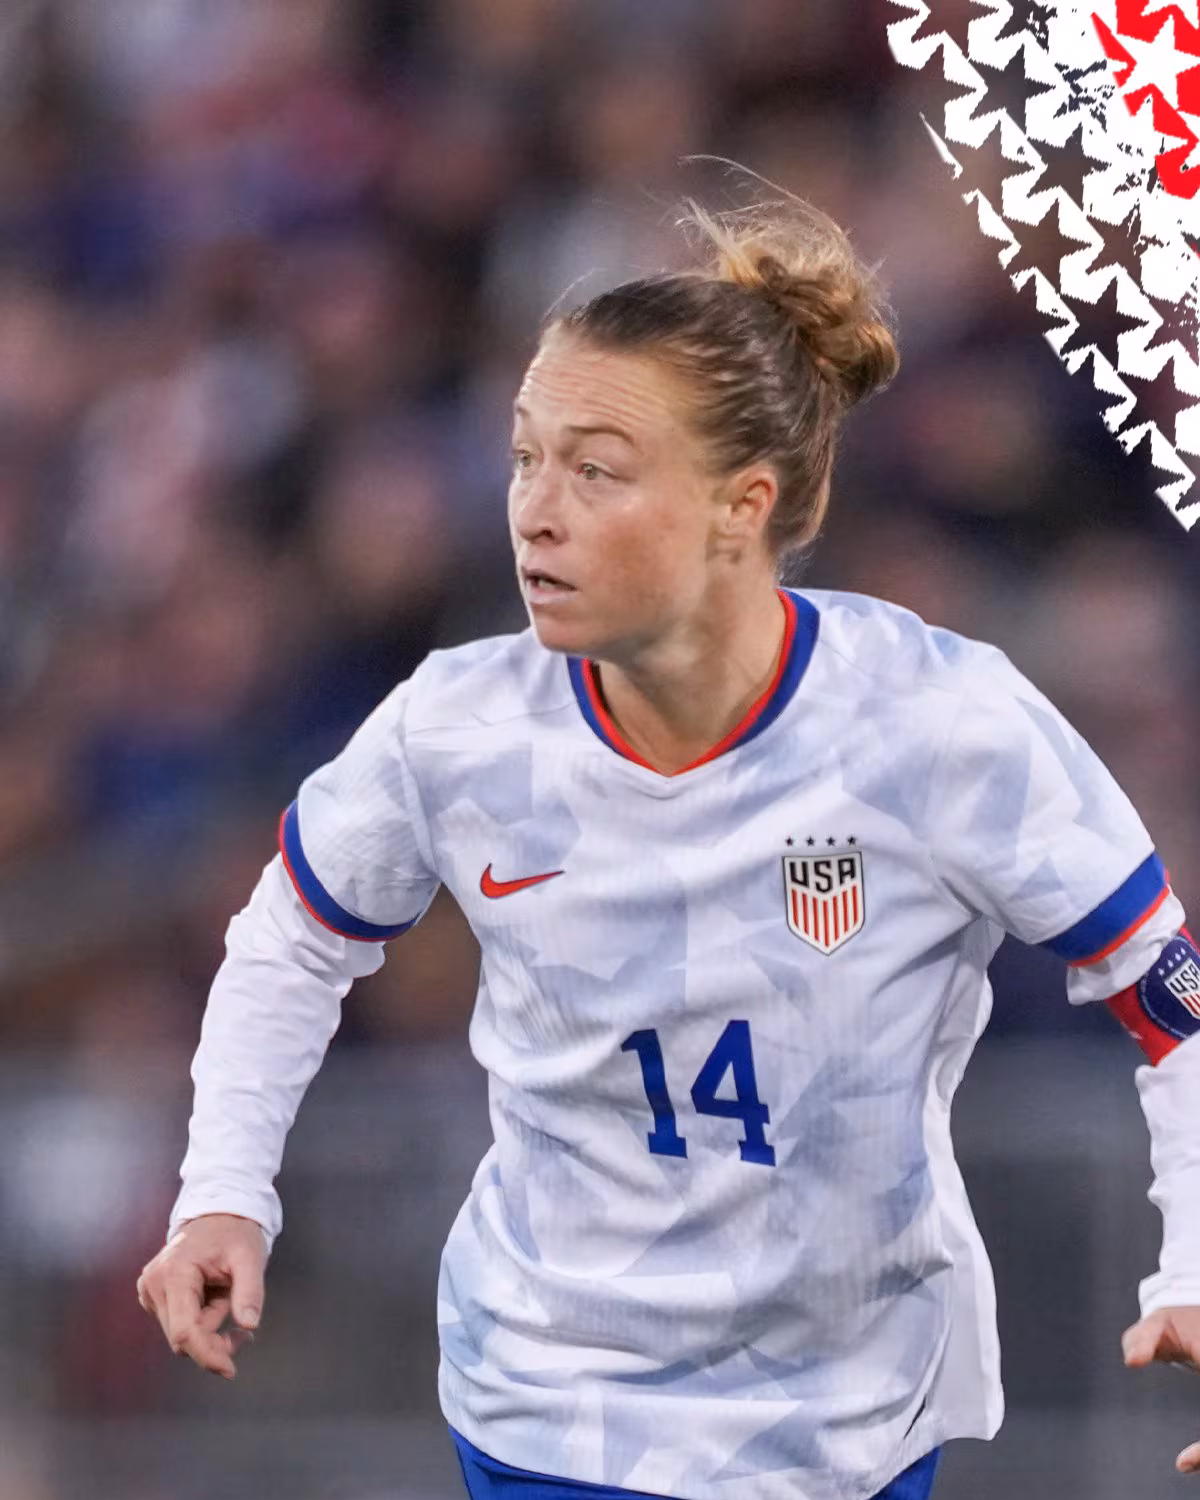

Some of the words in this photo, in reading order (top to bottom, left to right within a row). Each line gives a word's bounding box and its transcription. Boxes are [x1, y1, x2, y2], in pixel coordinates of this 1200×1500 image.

[789, 857, 856, 893] USA
[1169, 963, 1200, 994] USA
[620, 1019, 776, 1167] 14
